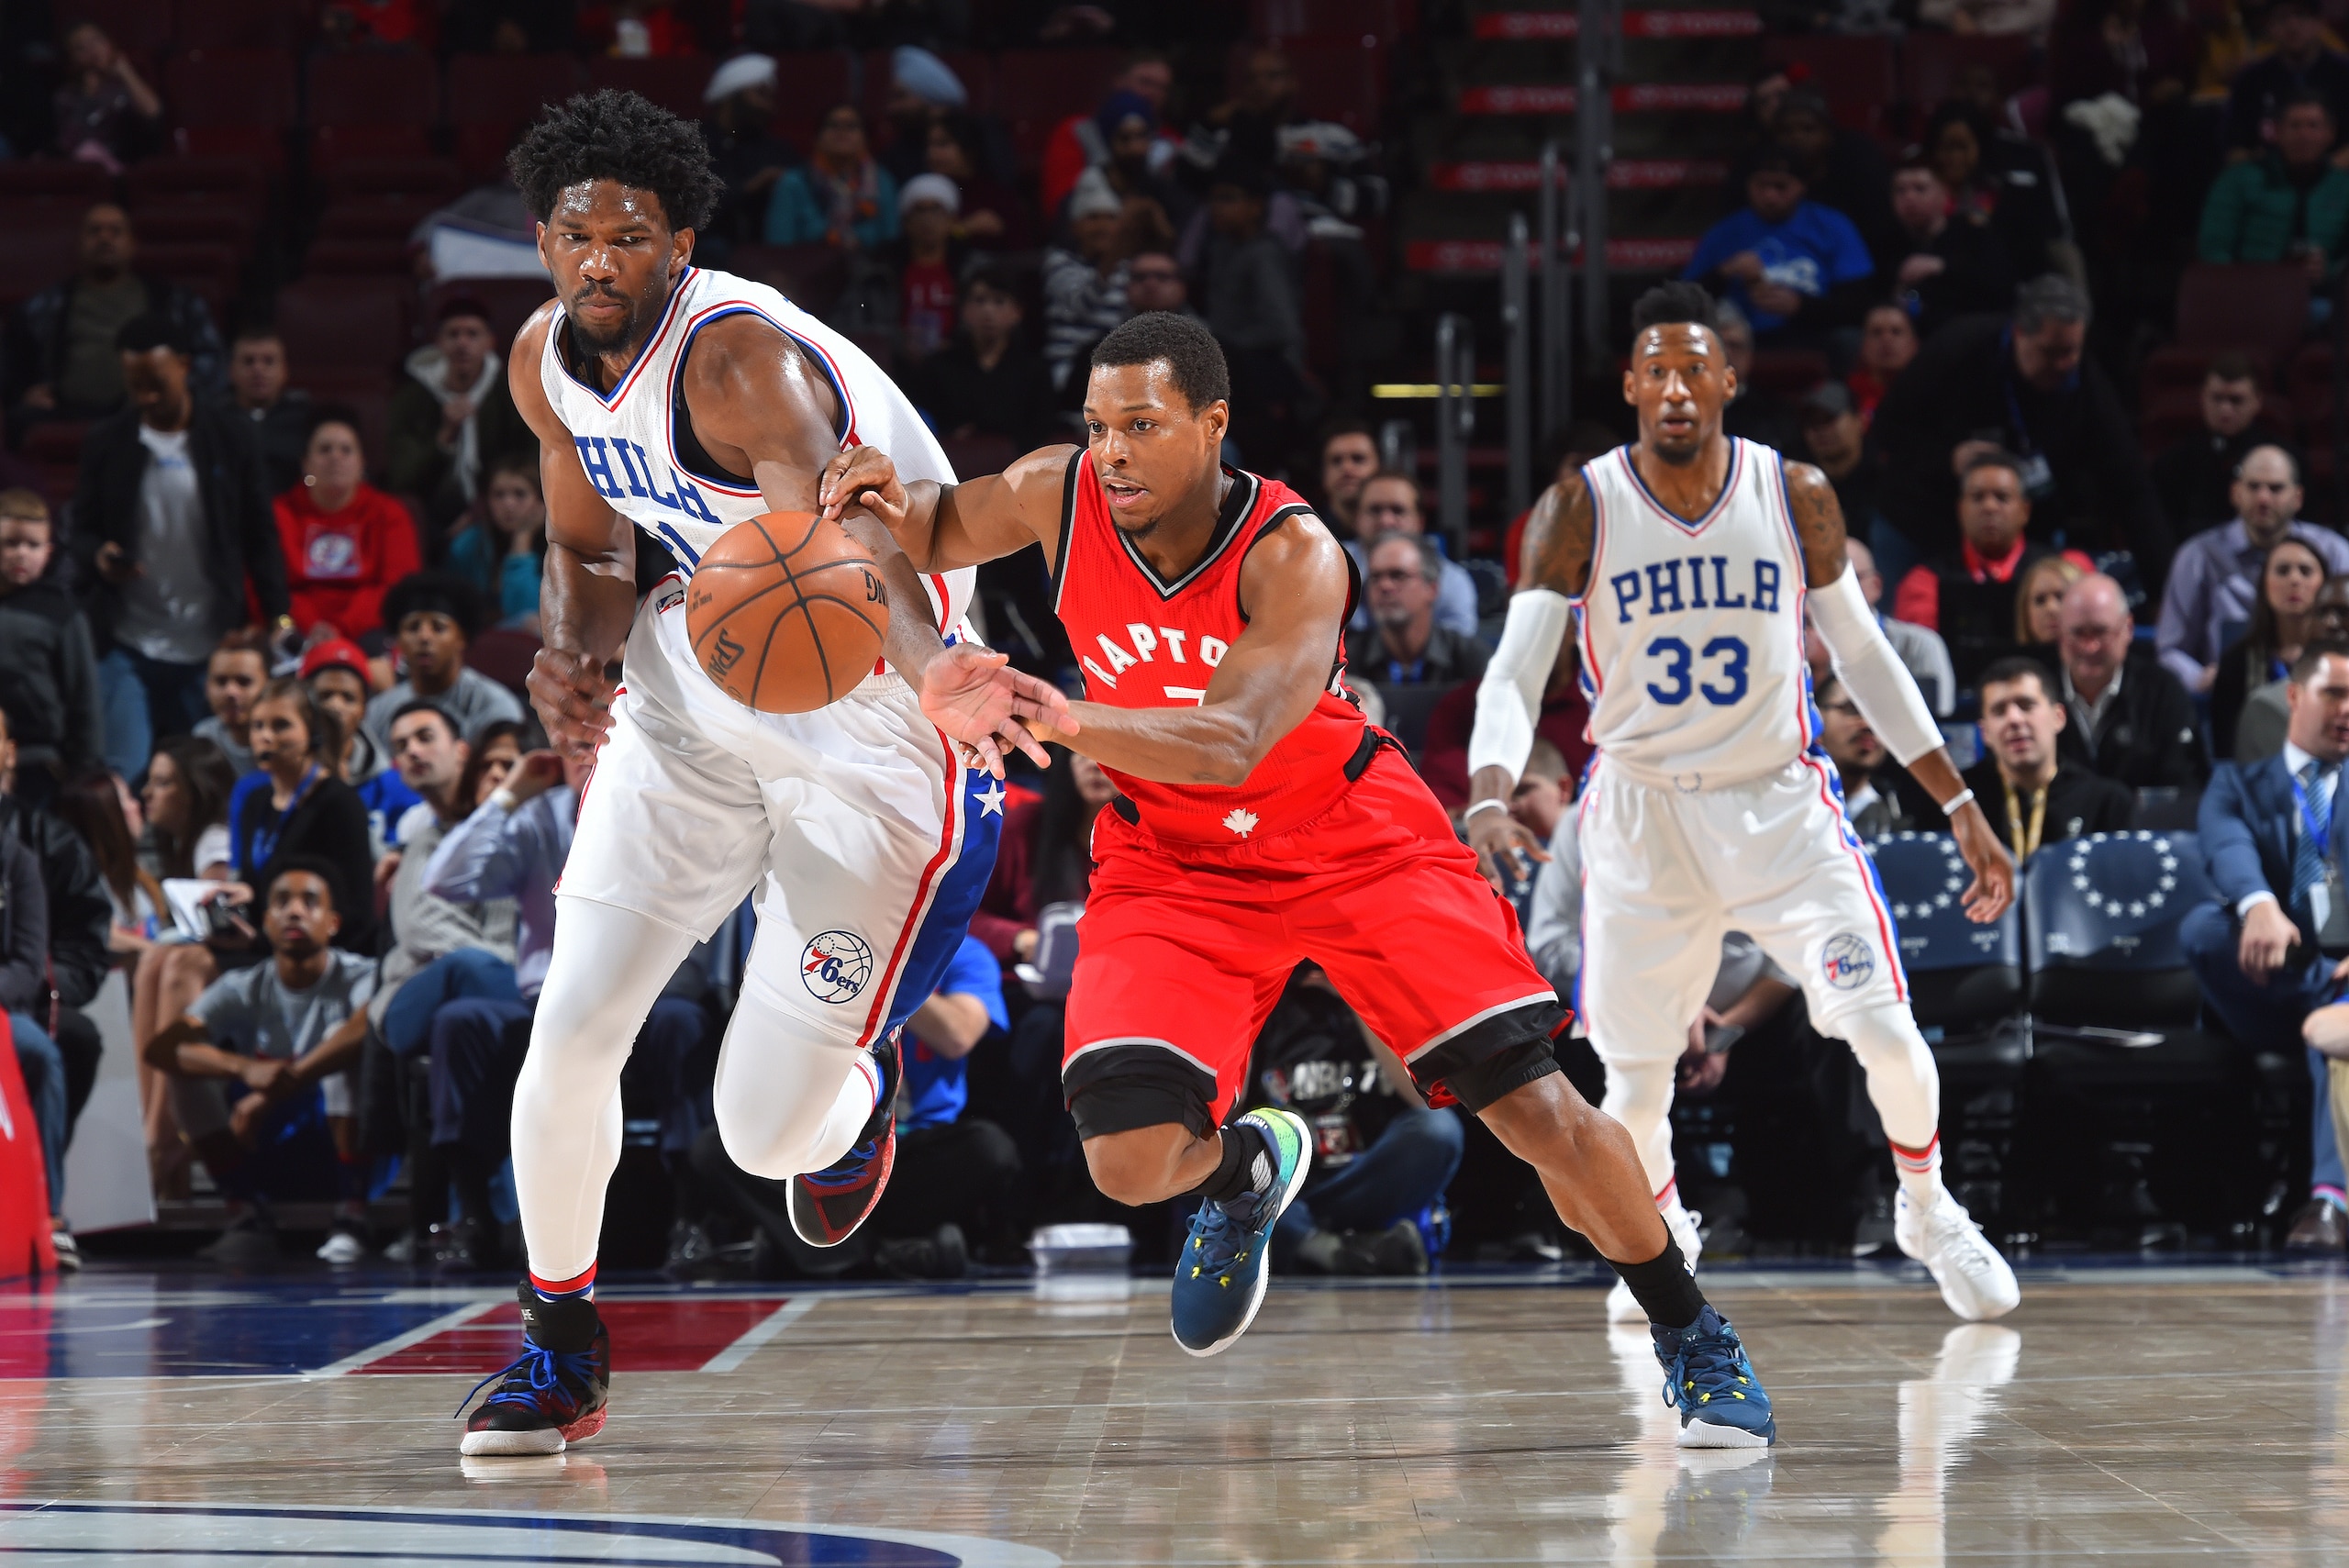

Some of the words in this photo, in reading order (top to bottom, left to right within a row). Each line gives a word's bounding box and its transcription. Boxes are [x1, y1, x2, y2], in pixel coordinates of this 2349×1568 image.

[573, 436, 723, 524] HILA
[656, 520, 702, 579] 1
[1610, 555, 1780, 624] PHILA
[1083, 622, 1230, 690] RAPTO
[1647, 636, 1750, 706] 33
[804, 946, 861, 994] 76ers
